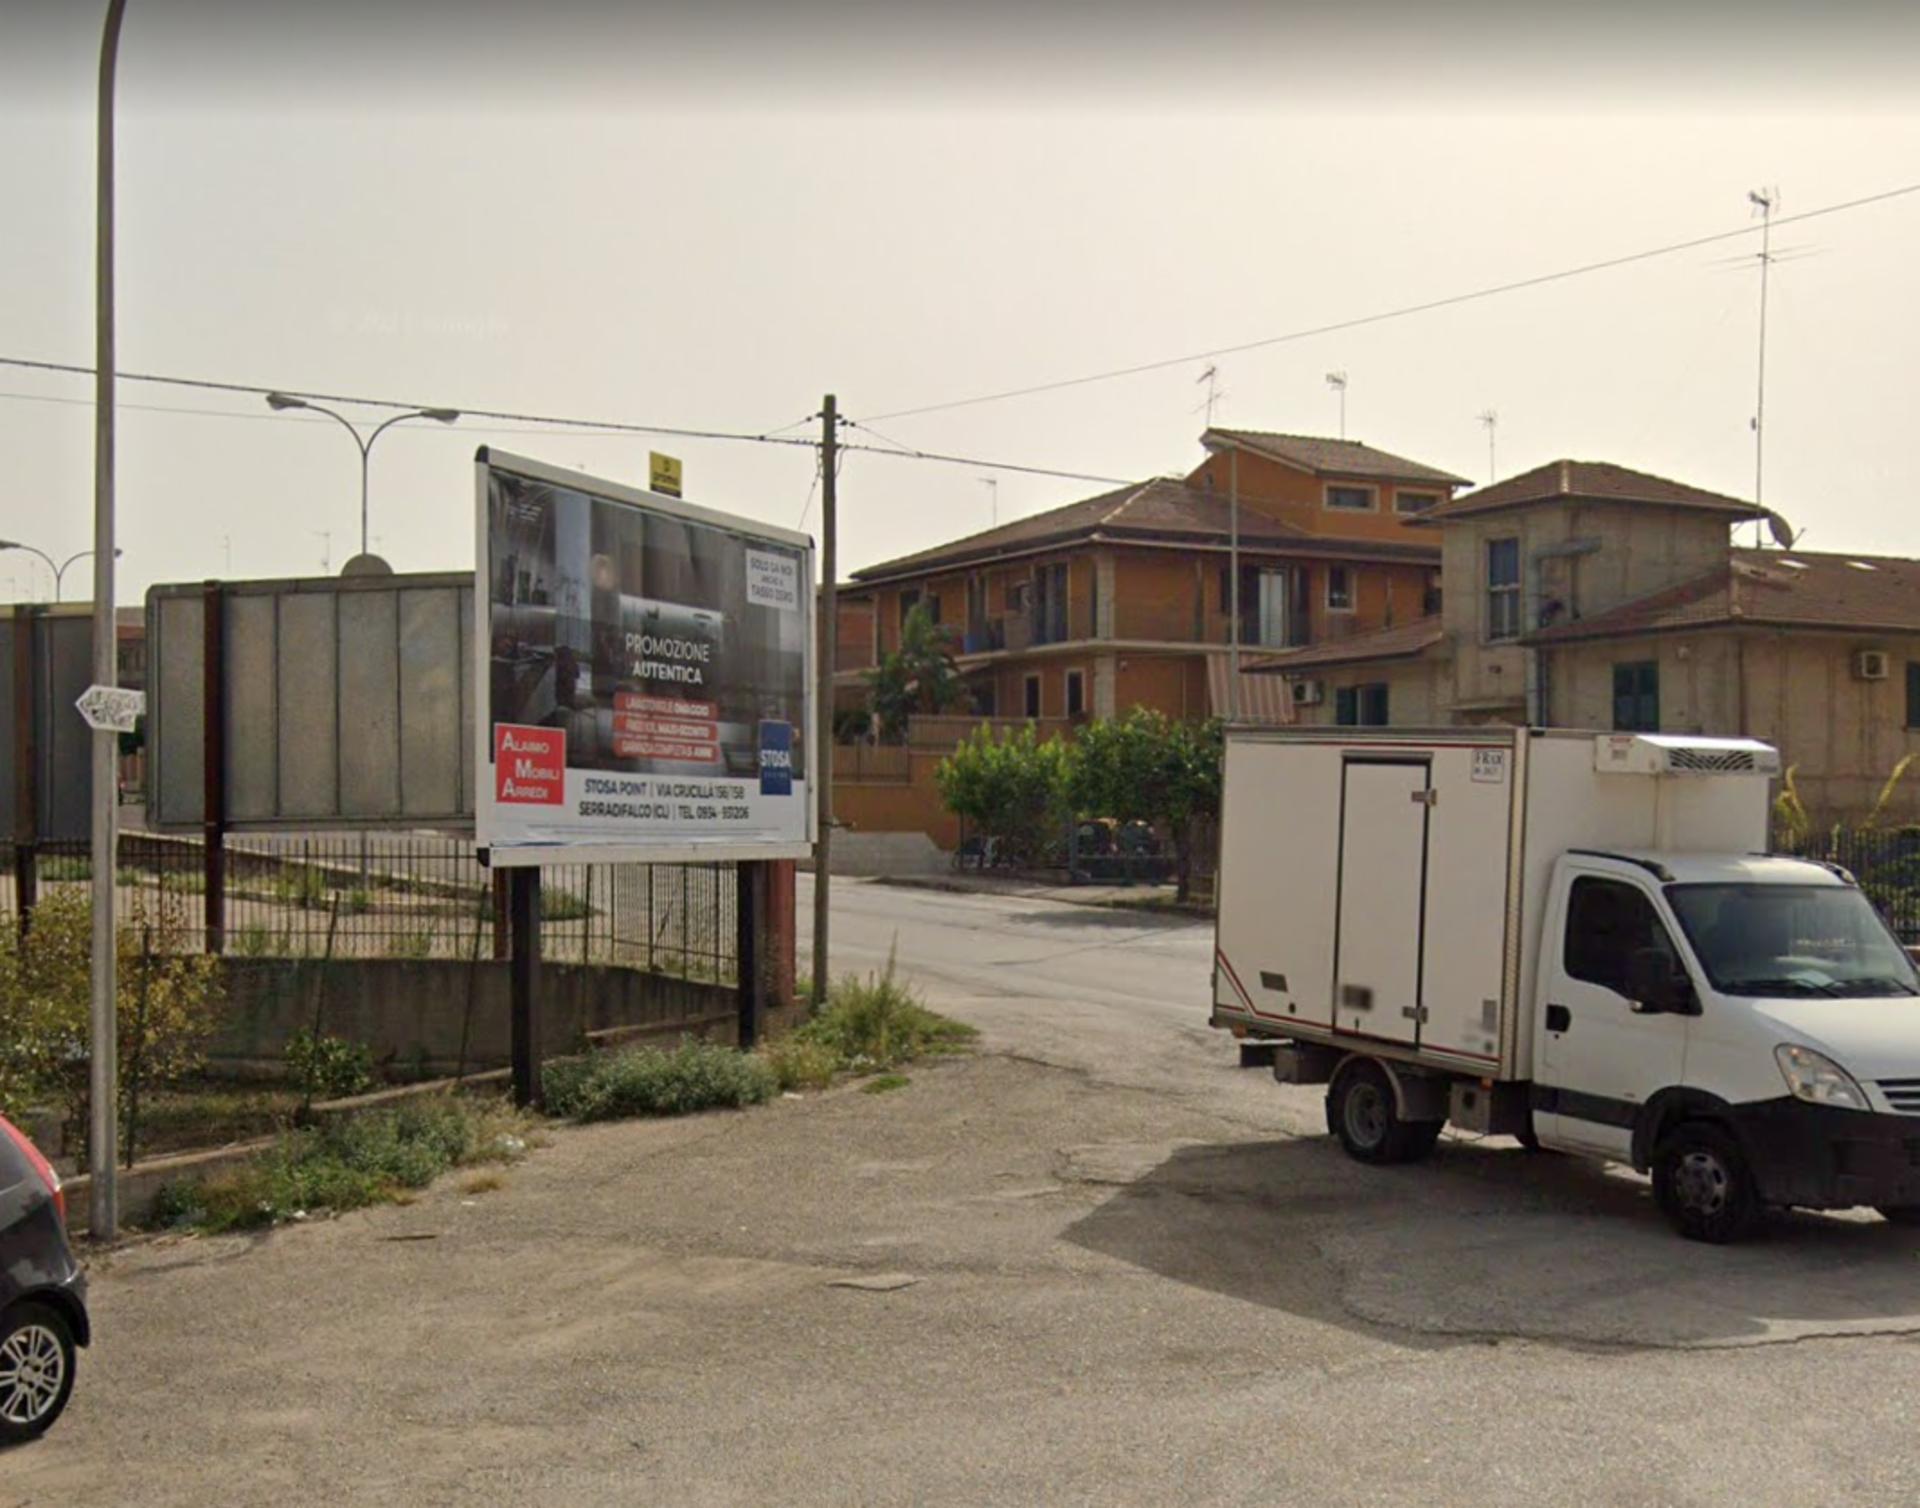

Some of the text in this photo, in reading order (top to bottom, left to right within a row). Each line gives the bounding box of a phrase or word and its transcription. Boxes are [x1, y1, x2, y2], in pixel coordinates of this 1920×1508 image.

[625, 632, 710, 662] PROMOZIONE
[632, 660, 703, 685] AUTENTICA
[760, 749, 792, 768] STOSA
[584, 778, 618, 796] STOSA
[619, 780, 647, 797] POINT
[656, 783, 673, 797] VIA
[579, 800, 652, 819] SERRADIFALCO
